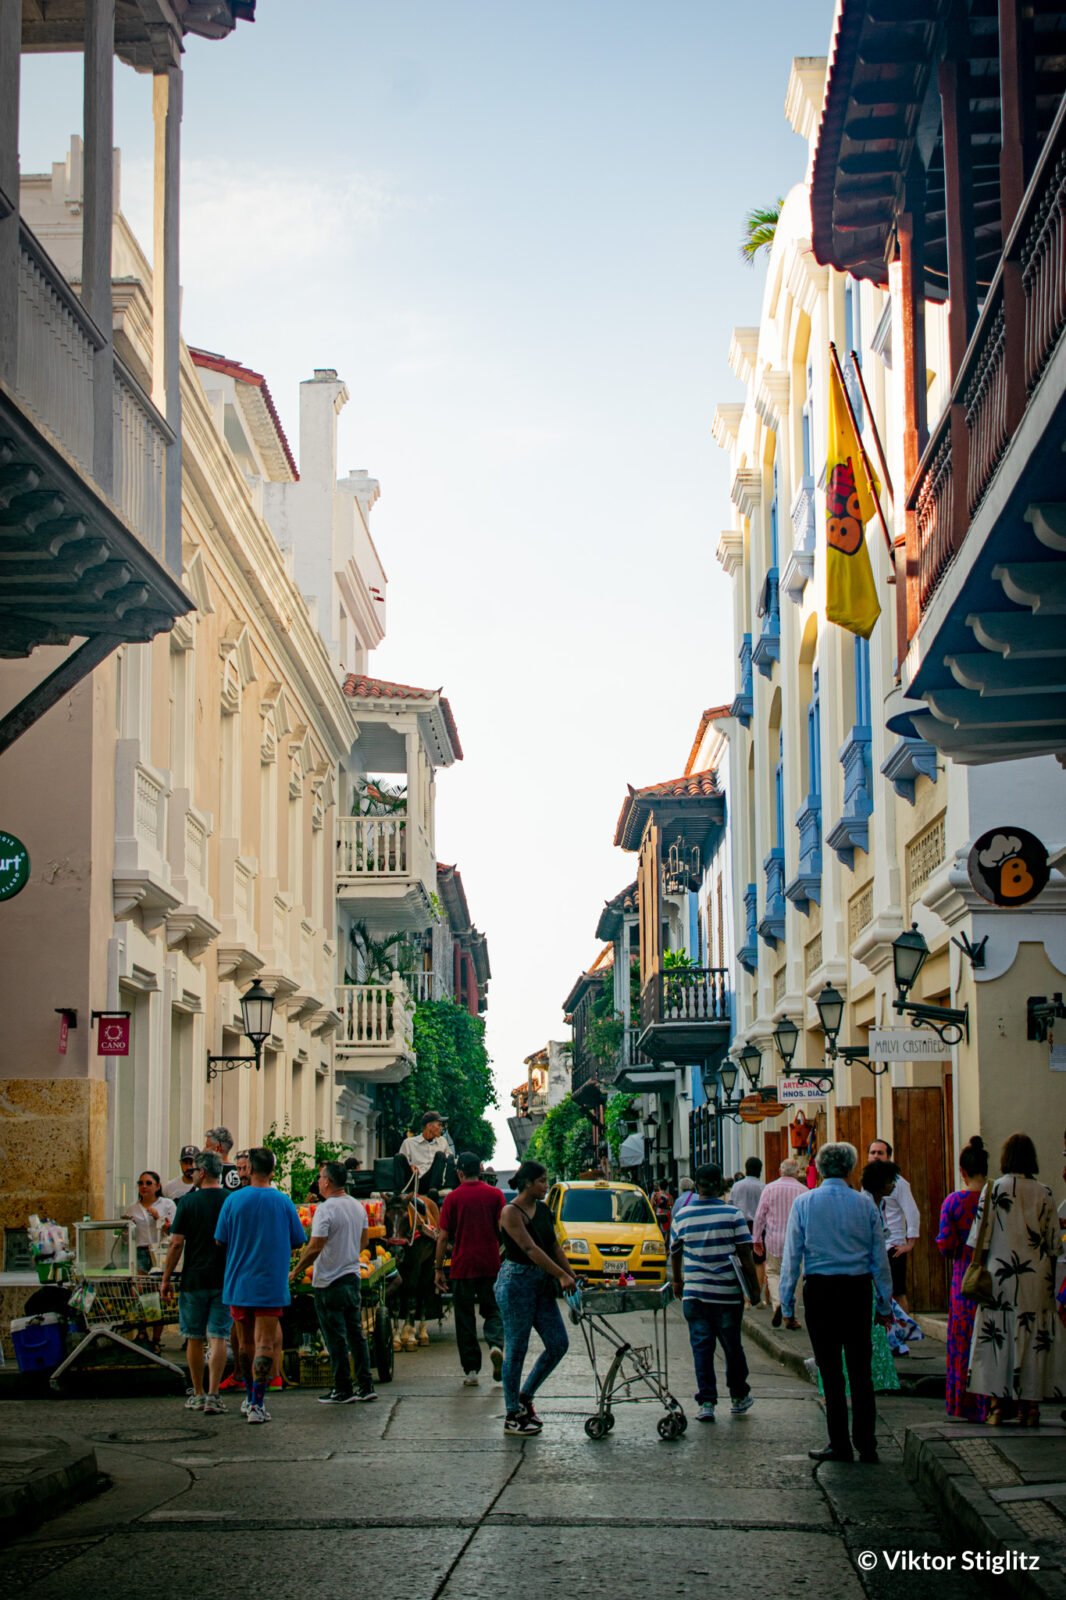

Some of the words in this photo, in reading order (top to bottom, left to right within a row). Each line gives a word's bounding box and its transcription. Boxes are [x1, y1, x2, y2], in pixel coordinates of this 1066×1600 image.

[0, 872, 20, 893] ELADO
[101, 1041, 126, 1049] CANO
[875, 1040, 899, 1053] MALVI
